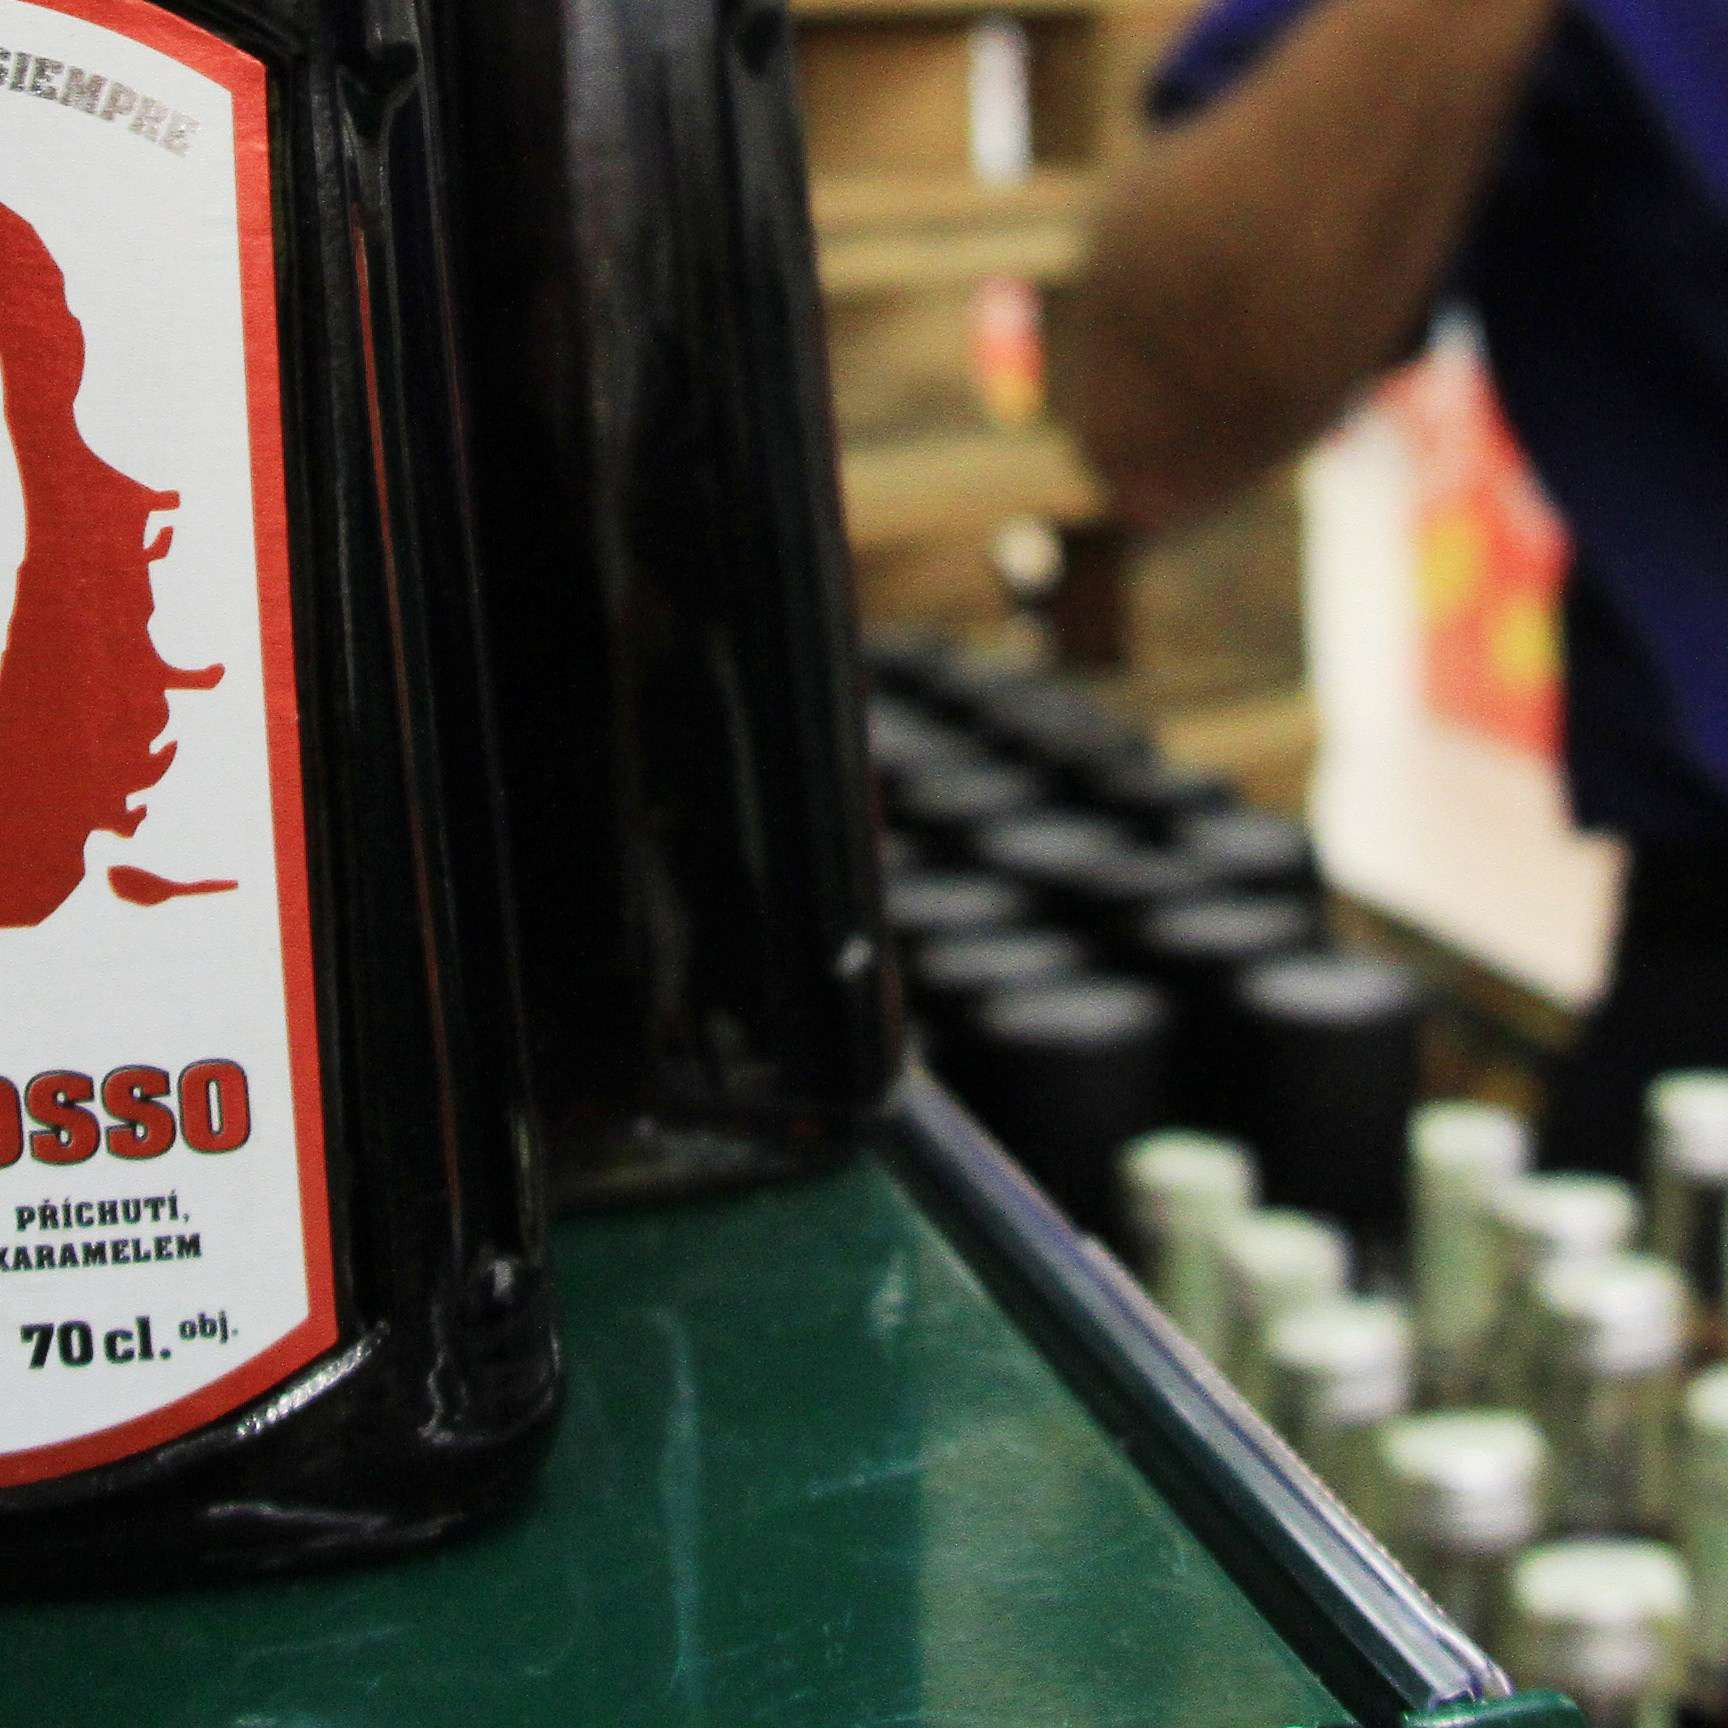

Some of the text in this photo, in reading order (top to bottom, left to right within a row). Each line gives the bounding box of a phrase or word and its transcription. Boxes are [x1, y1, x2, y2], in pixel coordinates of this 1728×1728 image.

[20, 1309, 239, 1371] 70 cl. obj.
